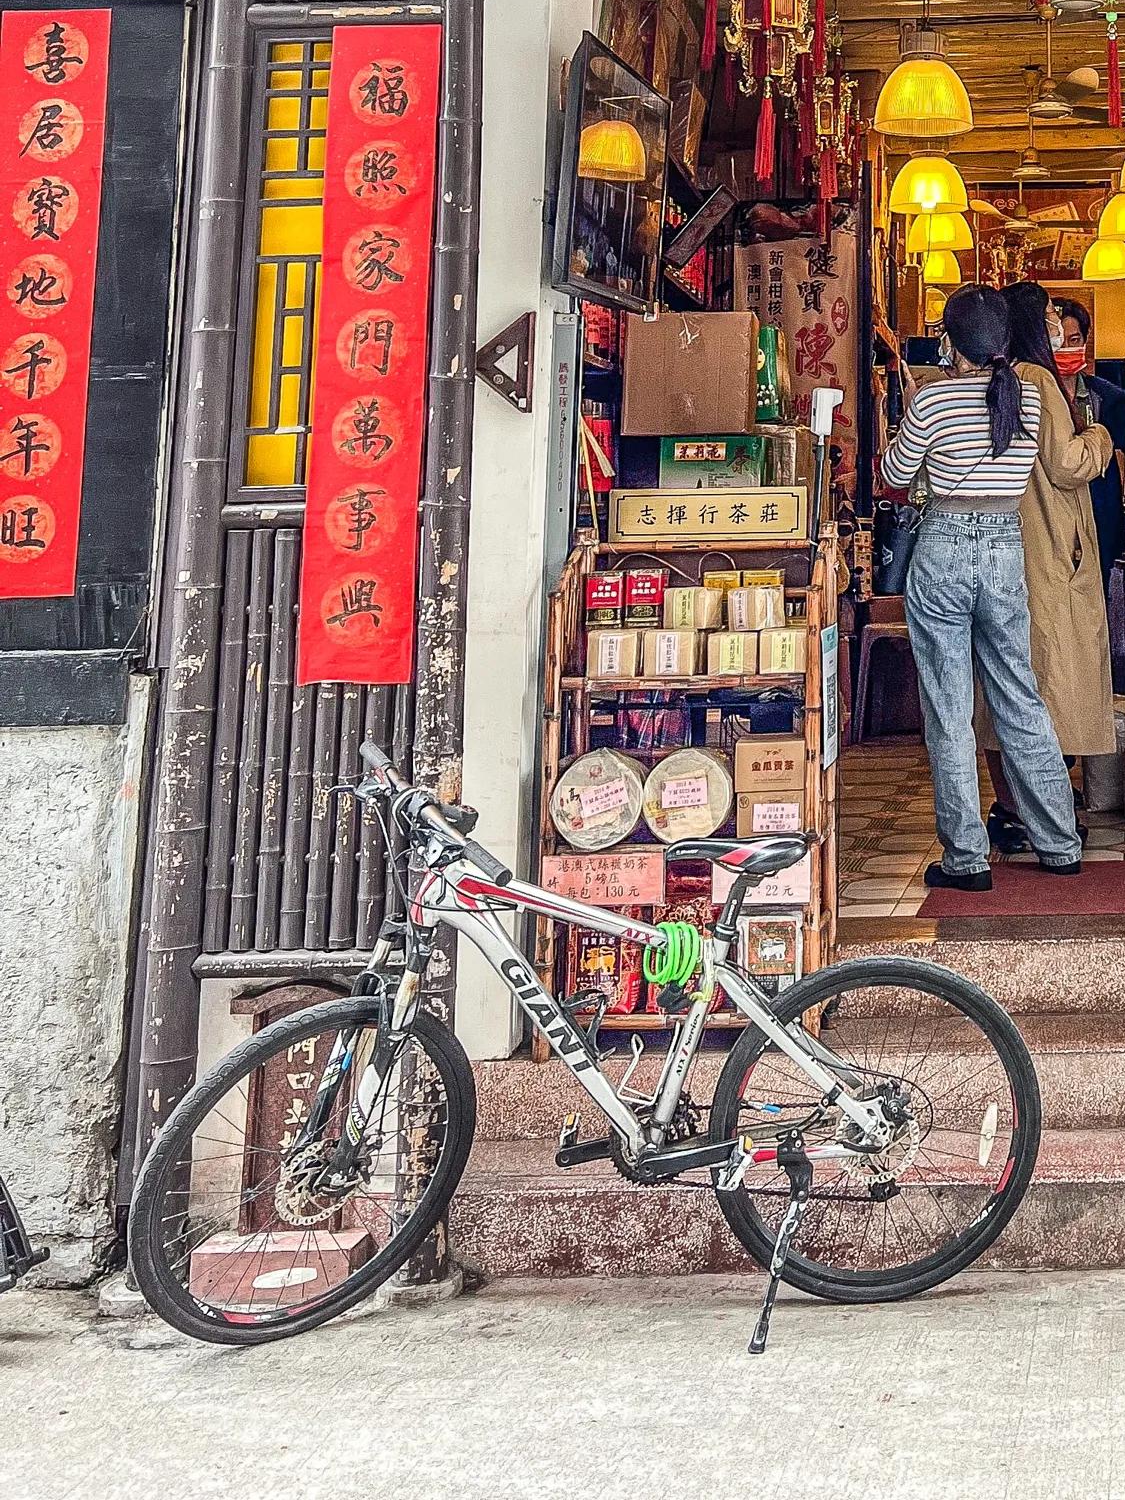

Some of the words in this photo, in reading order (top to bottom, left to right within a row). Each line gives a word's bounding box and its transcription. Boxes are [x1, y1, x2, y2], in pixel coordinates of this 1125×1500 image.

[0, 21, 83, 551] 喜居寶地千年旺
[325, 61, 410, 628] 福照家門萬事興
[637, 503, 780, 526] 志揮行茶莊
